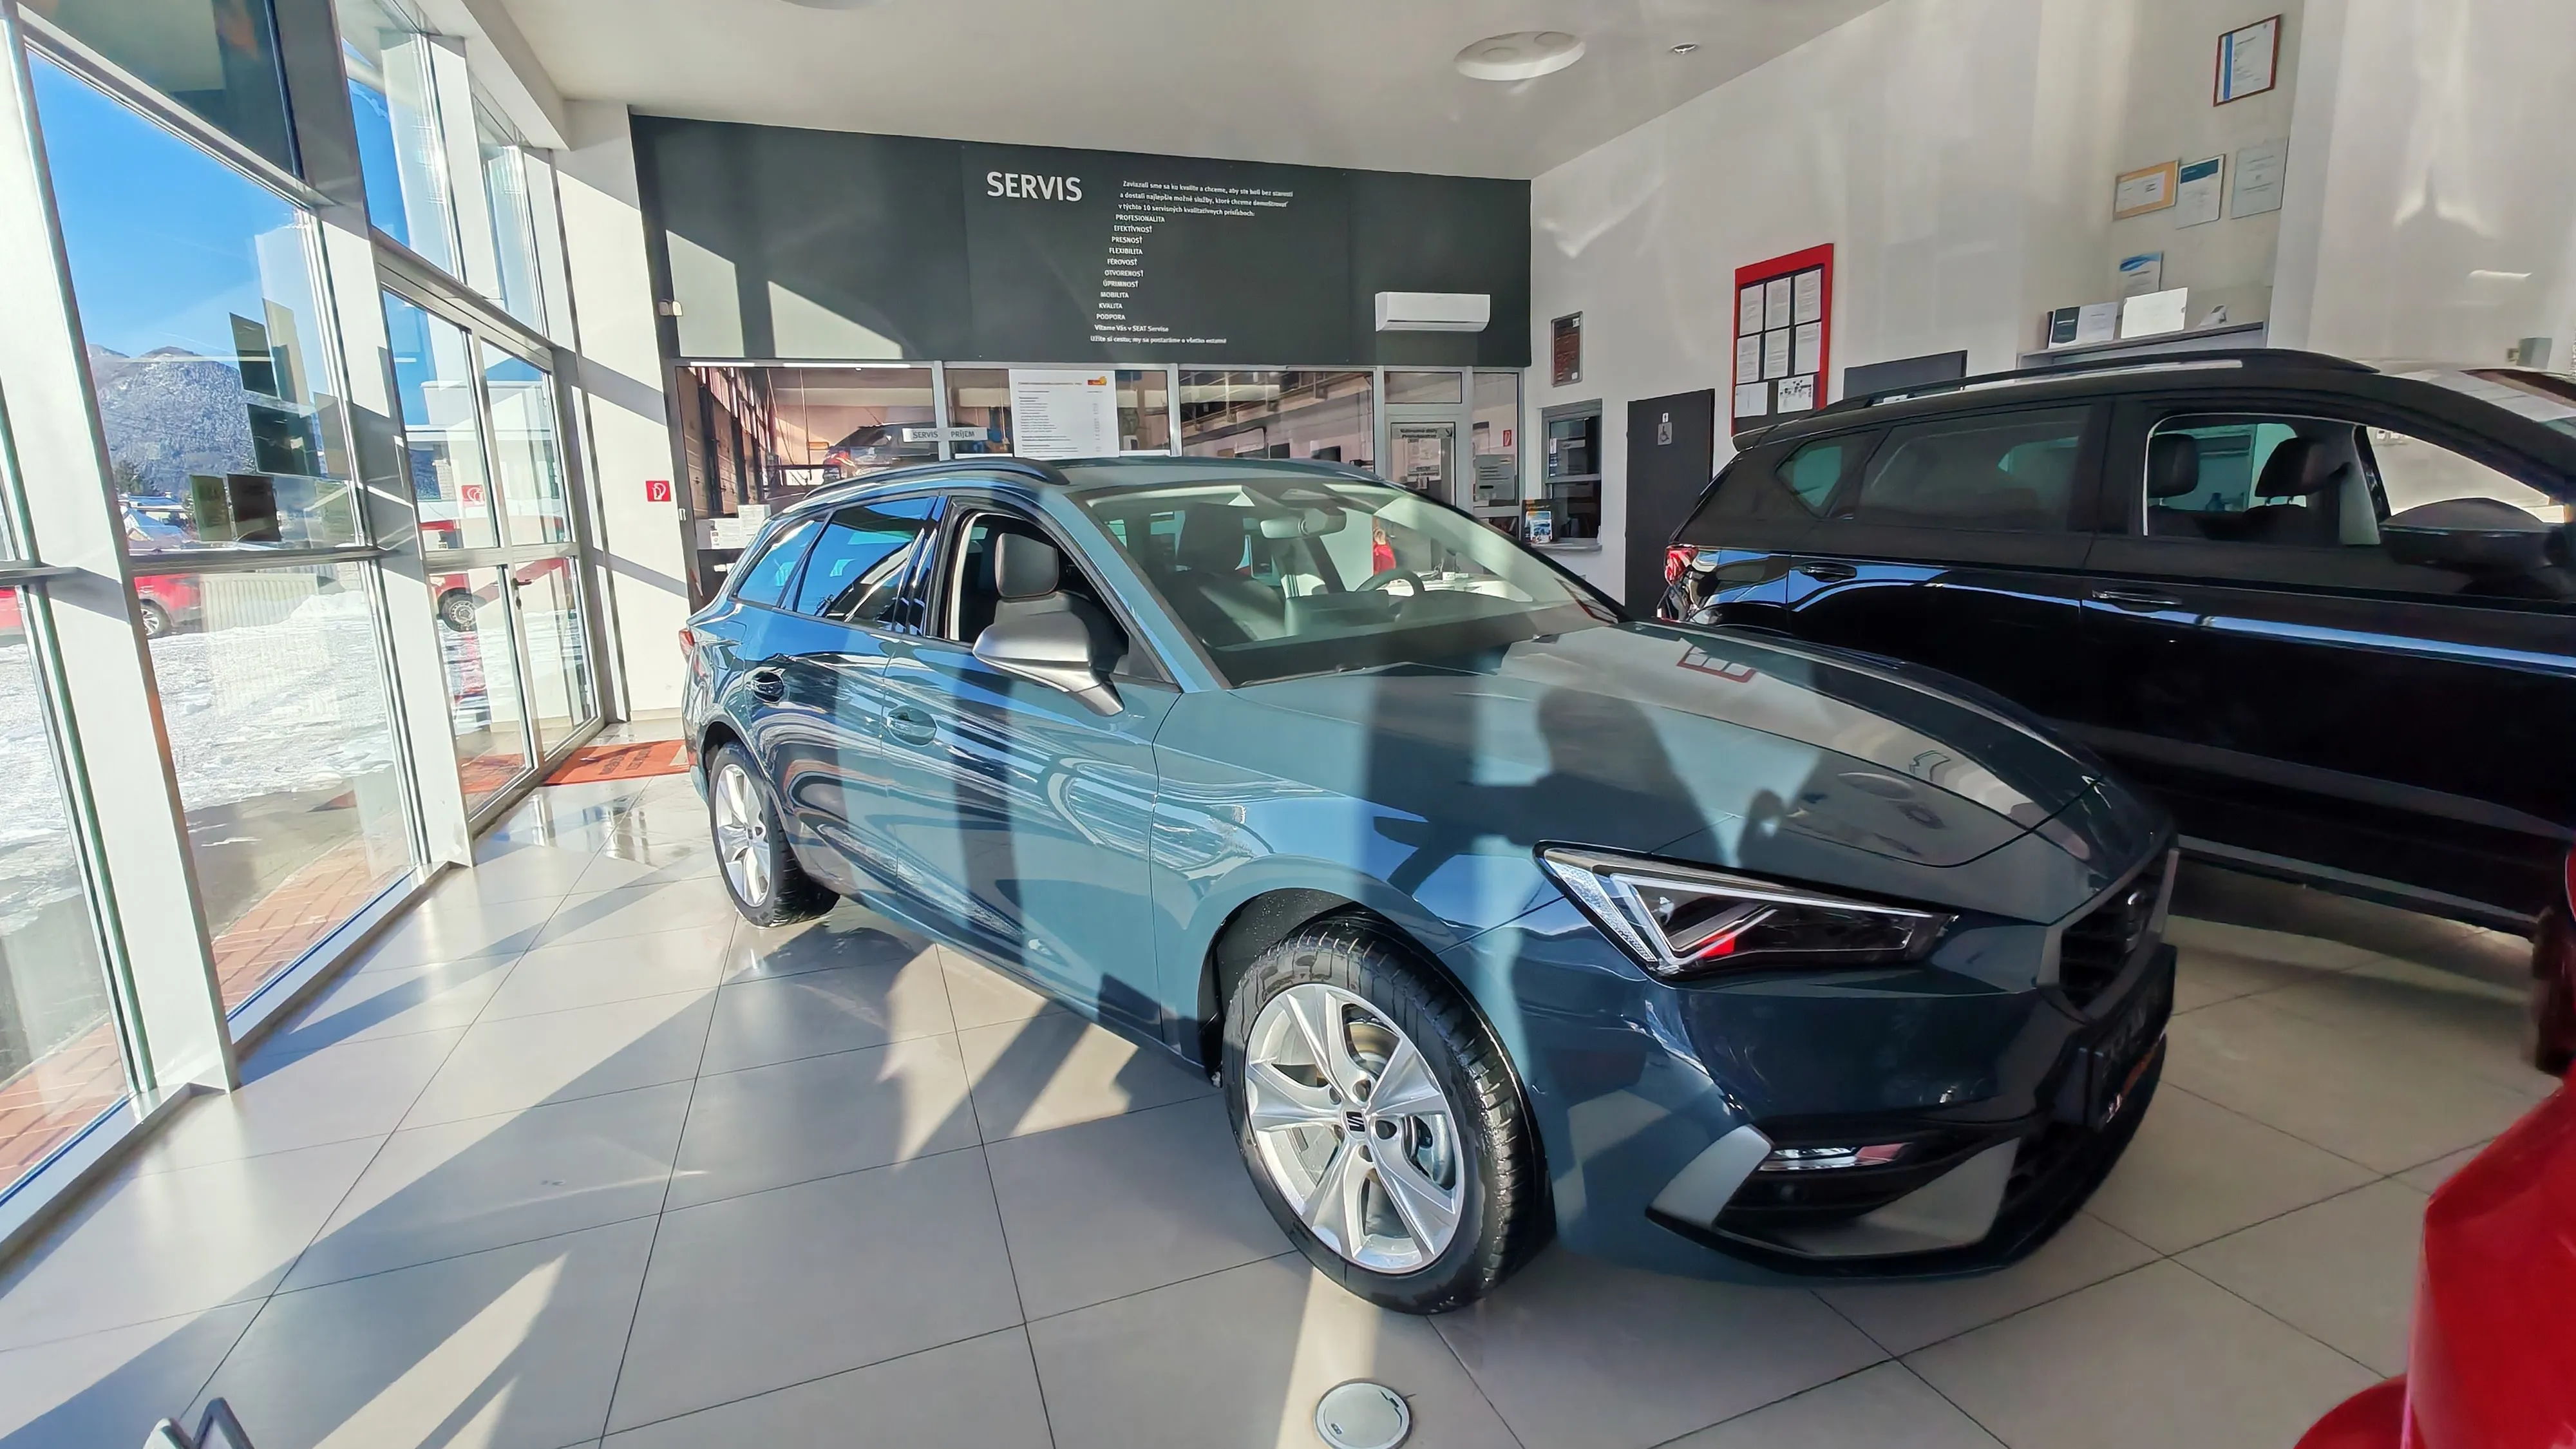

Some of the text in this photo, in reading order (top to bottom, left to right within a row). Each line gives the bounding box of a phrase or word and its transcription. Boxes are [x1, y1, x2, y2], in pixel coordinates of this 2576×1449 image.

[987, 171, 1083, 202] SERVIS
[1115, 214, 1166, 223] PROFESIONALITA
[1113, 225, 1153, 233] EFEKTÍVNOSŤ
[1112, 236, 1142, 244] PRESNOSŤ
[1103, 279, 1139, 288] ÚPRIMNOSŤ
[951, 430, 975, 439] PRÍJEM
